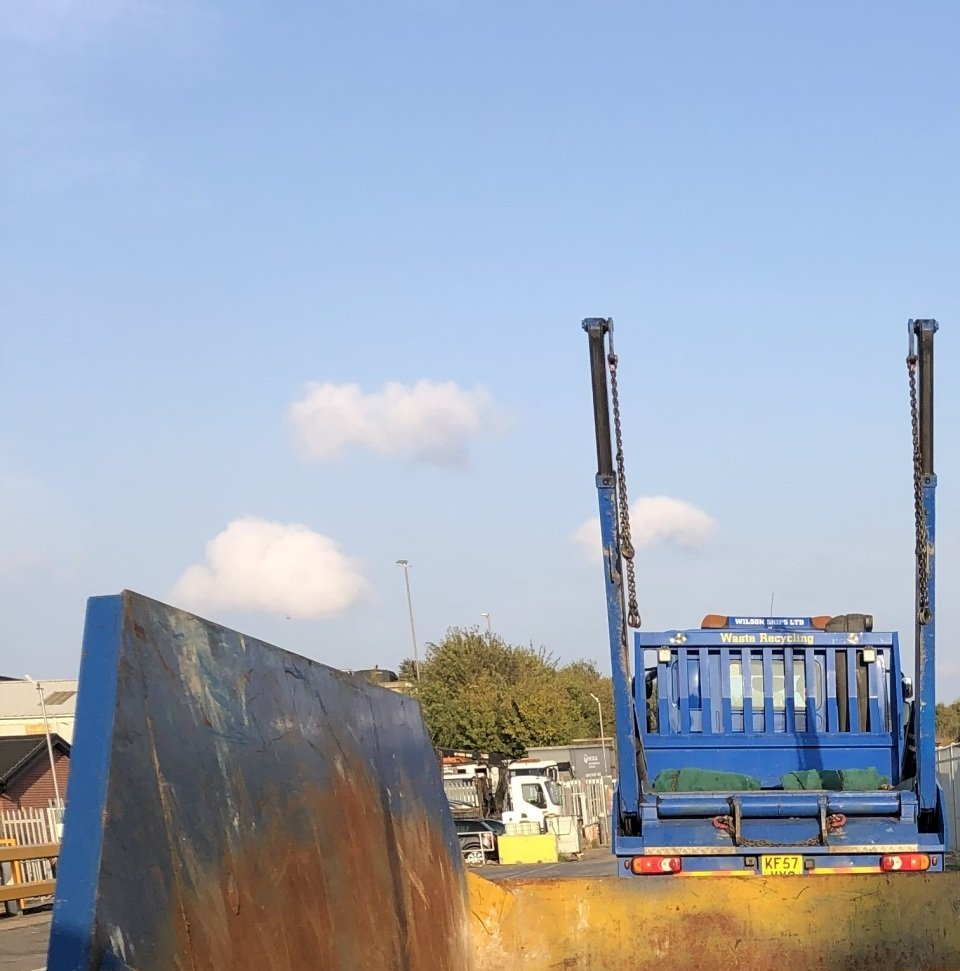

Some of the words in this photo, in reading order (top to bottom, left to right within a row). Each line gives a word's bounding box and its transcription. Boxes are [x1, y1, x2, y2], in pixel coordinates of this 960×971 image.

[766, 618, 789, 626] SKIPS
[790, 618, 805, 626] LTD
[719, 632, 756, 643] Waste
[759, 632, 815, 644] Recycling
[765, 857, 799, 869] KF57
